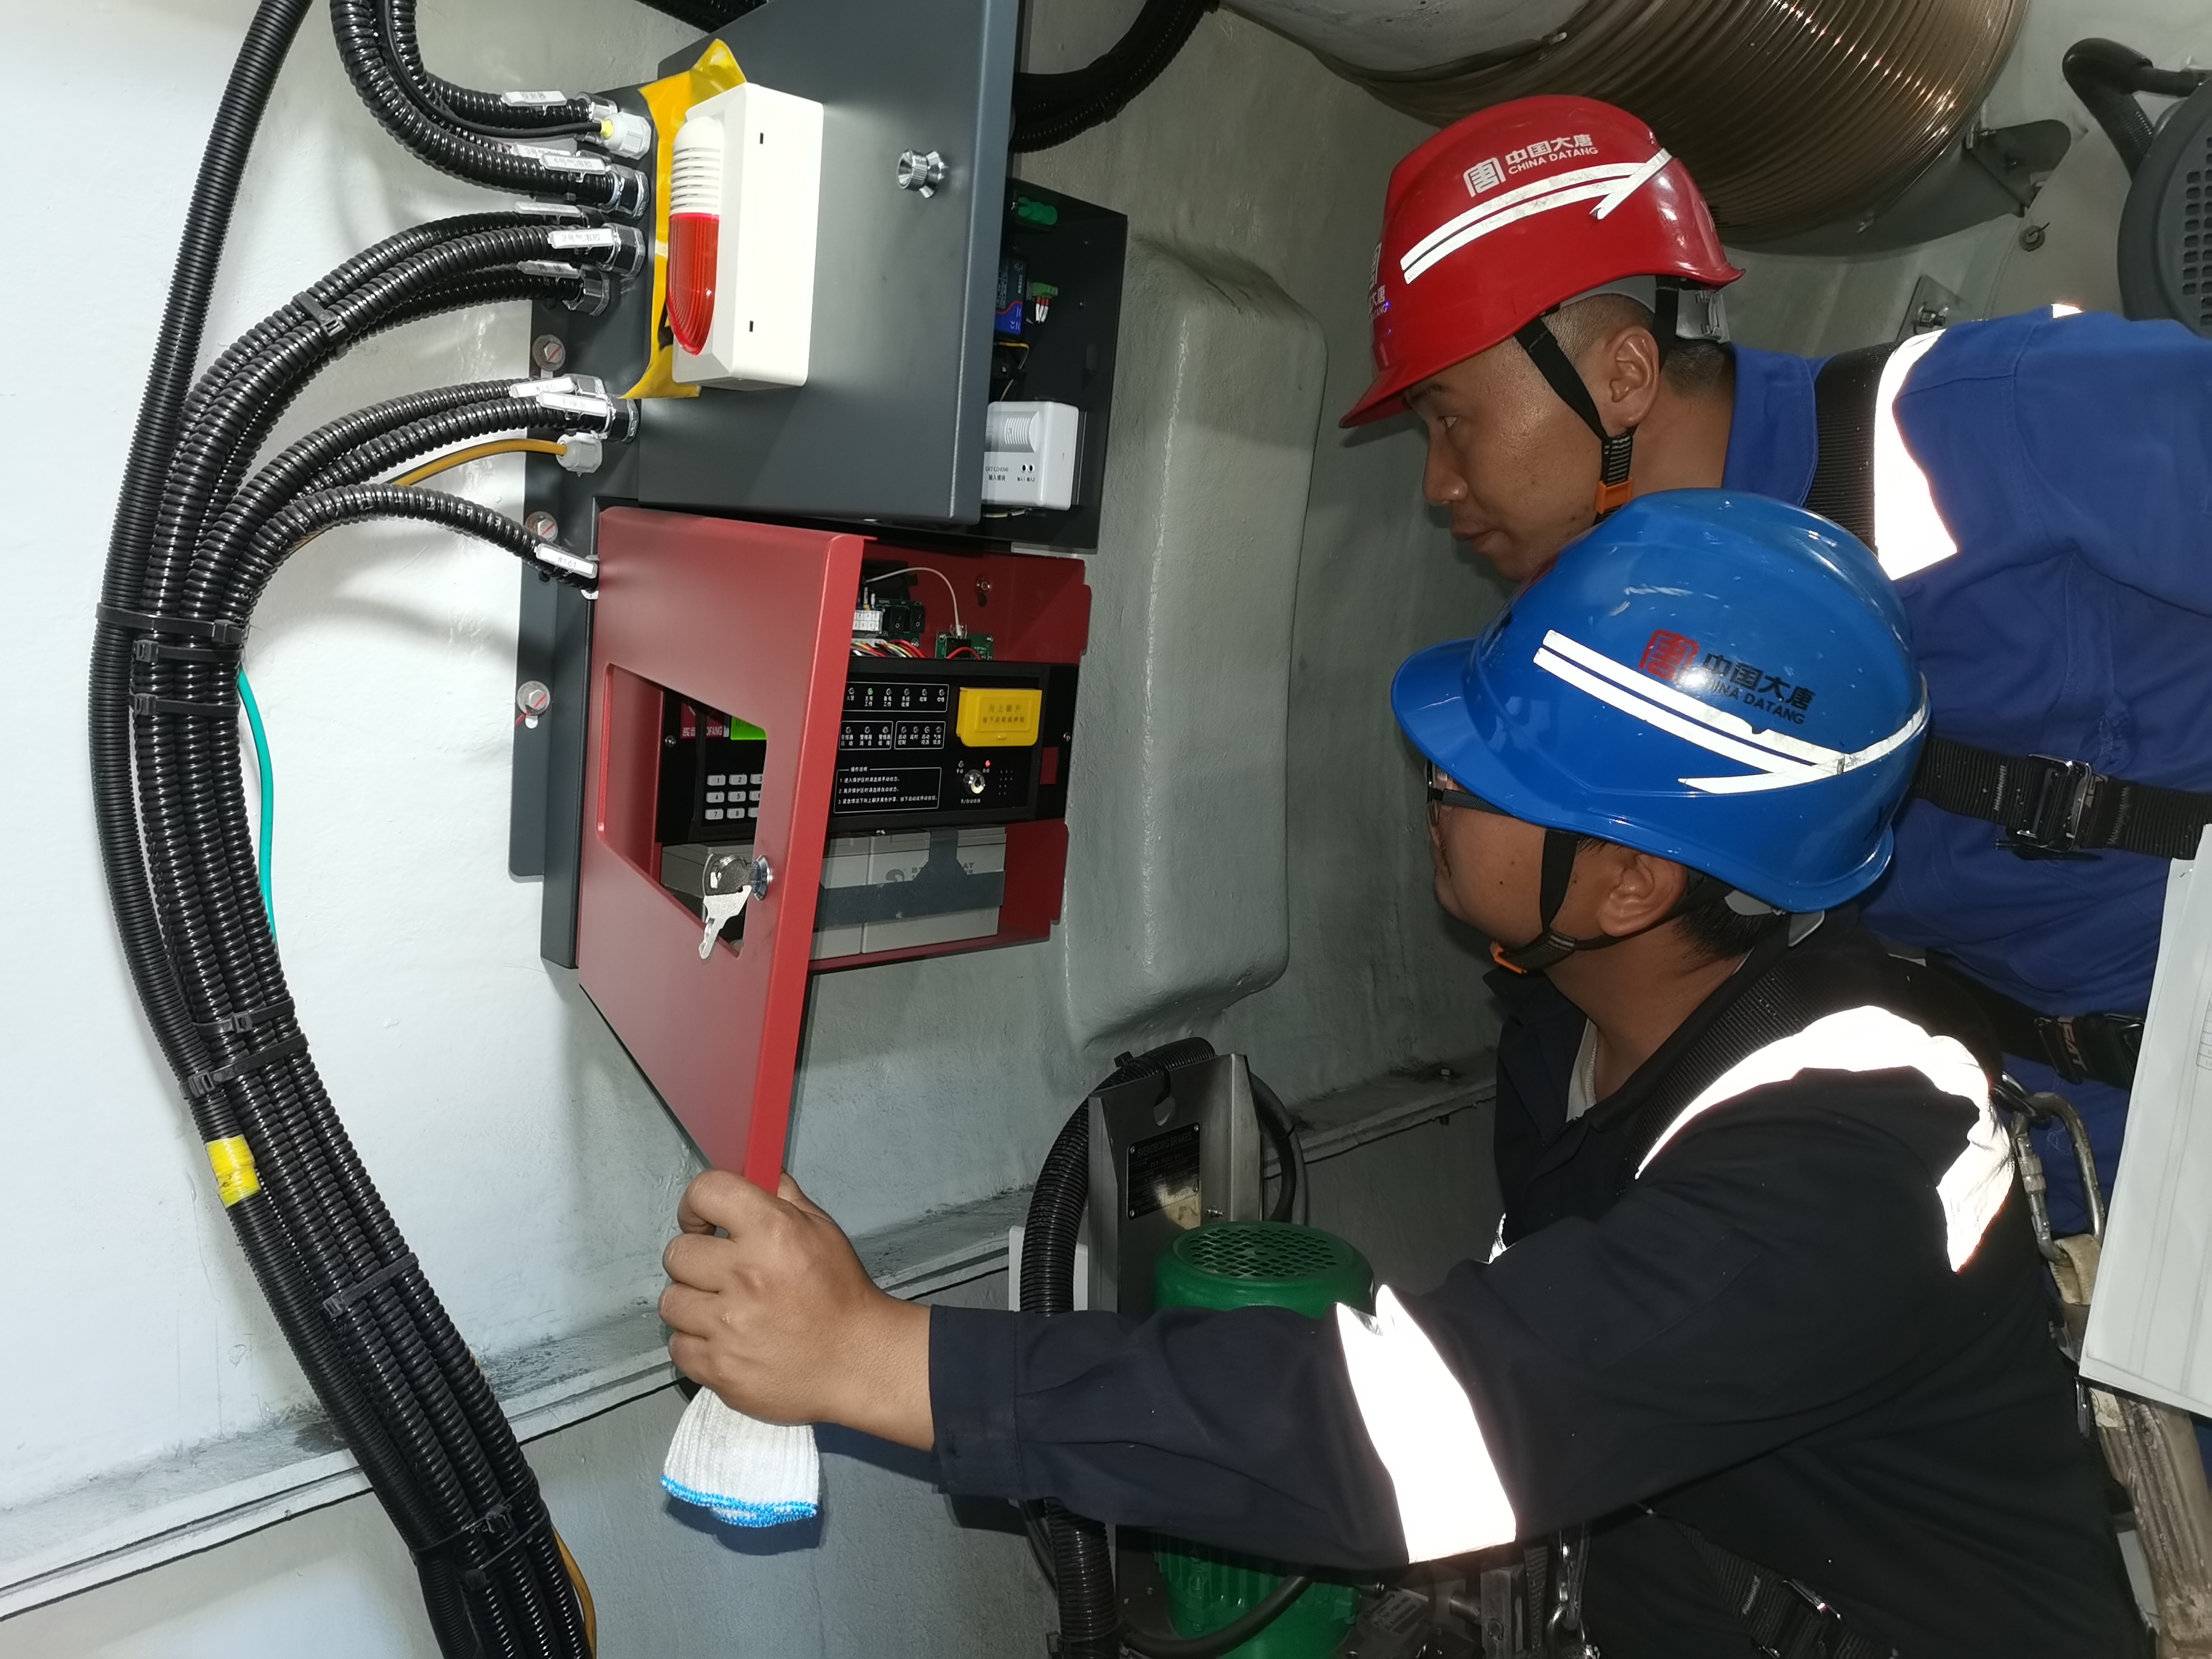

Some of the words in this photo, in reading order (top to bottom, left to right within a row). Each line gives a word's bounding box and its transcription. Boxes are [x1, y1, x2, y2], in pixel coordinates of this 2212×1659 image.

[1504, 134, 1594, 166] 中国大唐
[1507, 156, 1547, 175] CHINA
[1548, 147, 1599, 163] DATANG
[561, 233, 602, 244] 2号气溶胶
[535, 383, 556, 393] W160
[557, 555, 577, 569] W161
[1702, 653, 1817, 711] 中国大唐
[988, 704, 1021, 713] 向上翻开
[1743, 692, 1806, 725] DATANG
